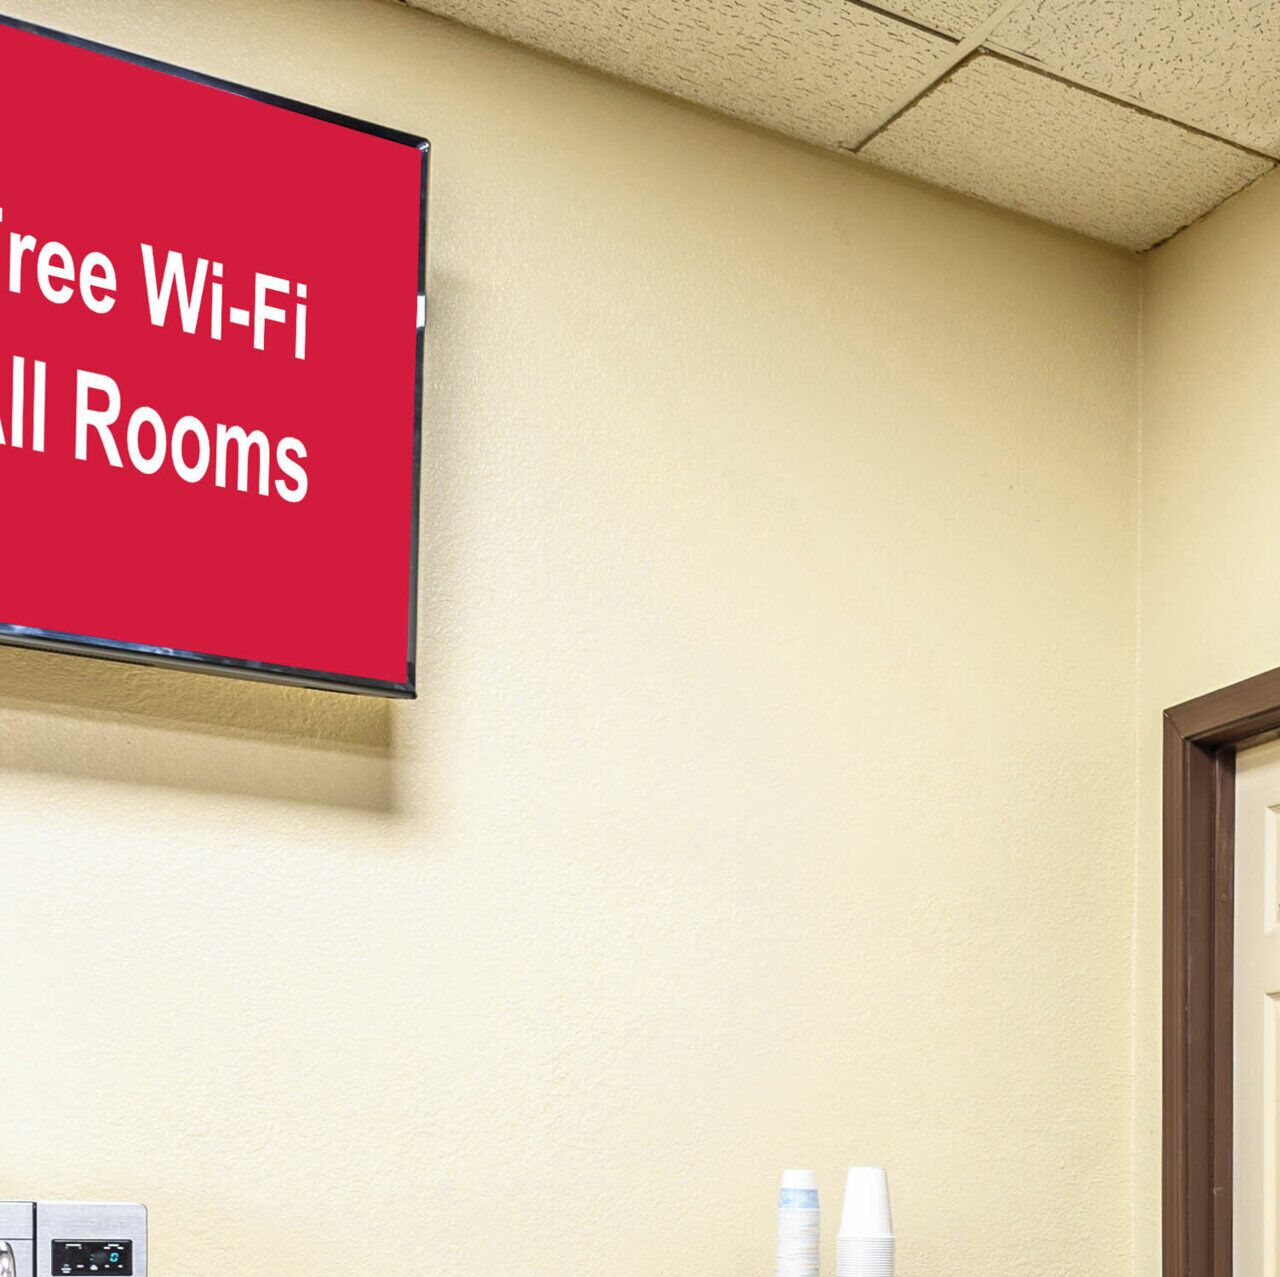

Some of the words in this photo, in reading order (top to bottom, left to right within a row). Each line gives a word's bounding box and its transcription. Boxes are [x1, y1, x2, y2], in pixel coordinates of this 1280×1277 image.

[0, 208, 116, 314] ree
[141, 243, 308, 361] Wi-Fi
[0, 356, 46, 453] ll
[75, 370, 309, 503] Rooms
